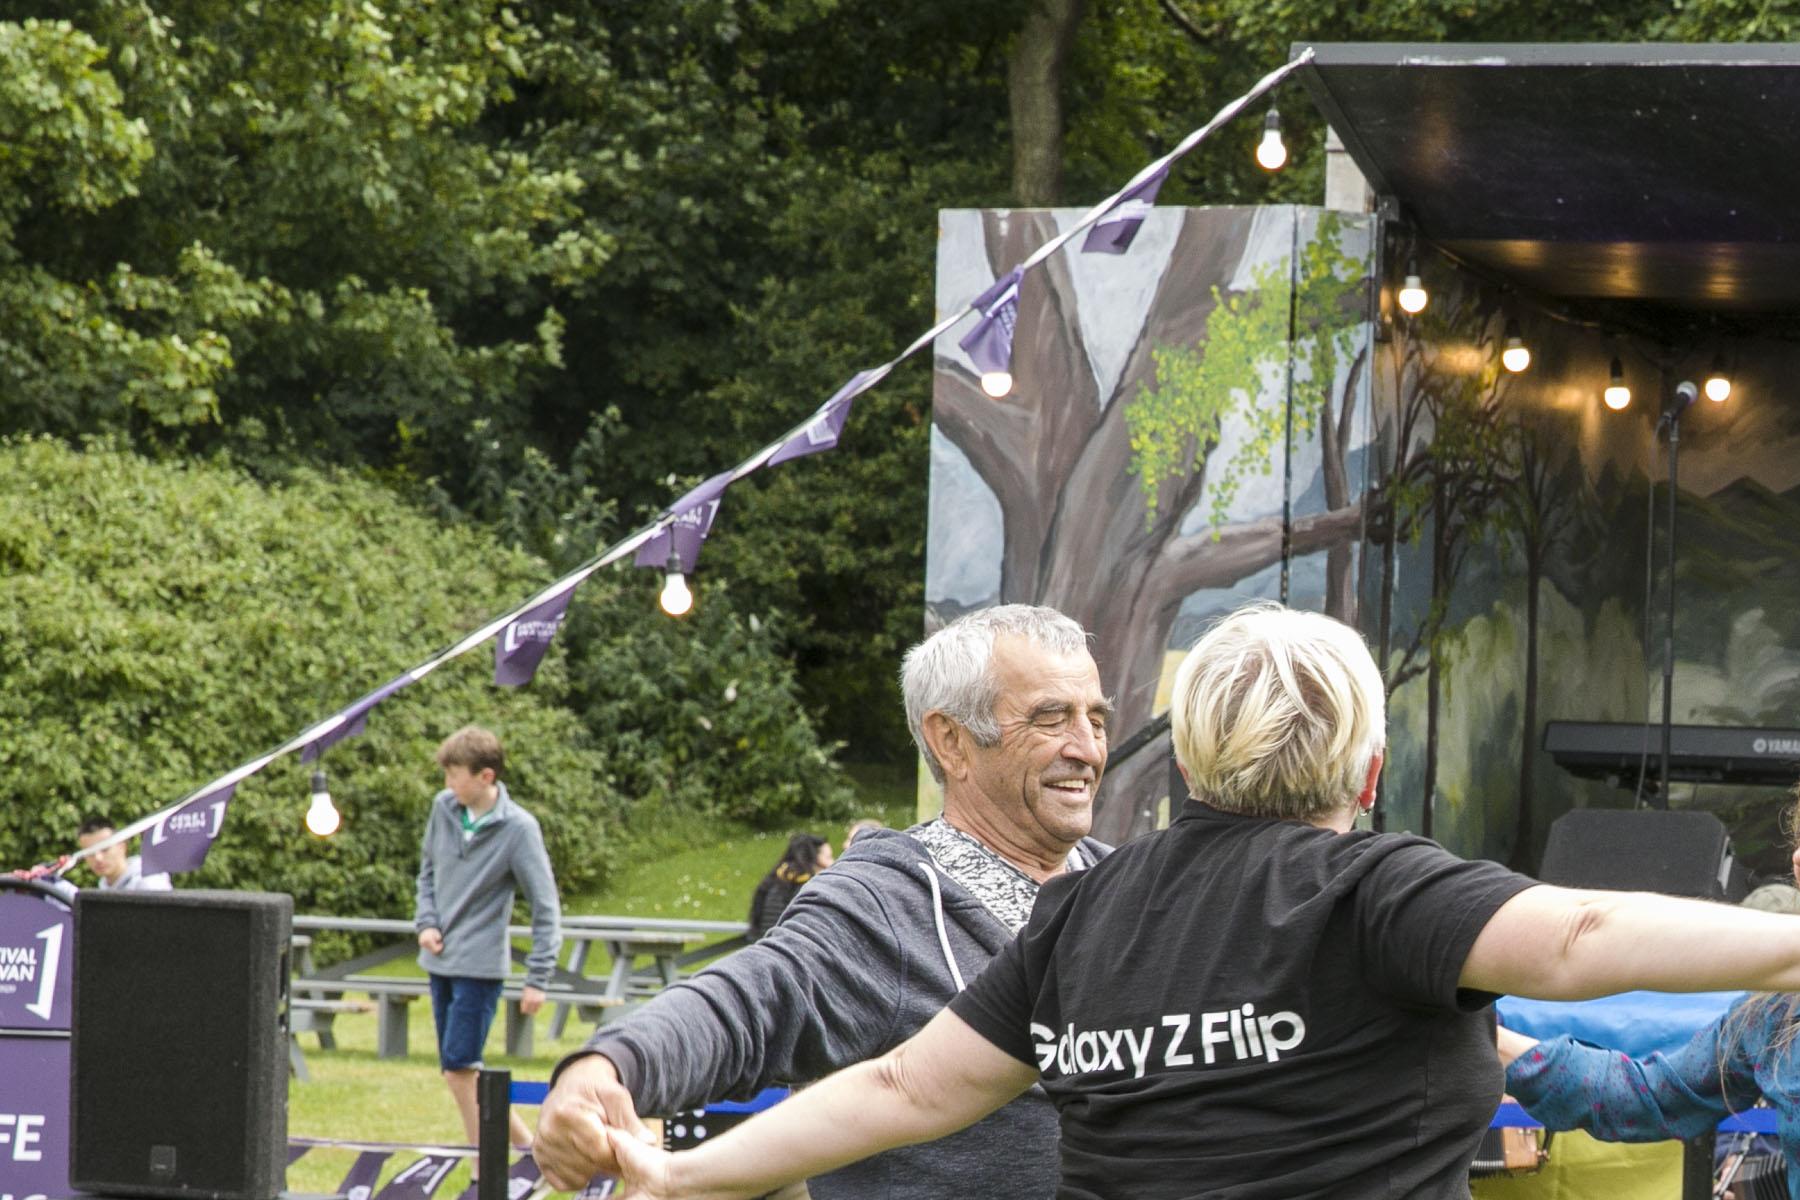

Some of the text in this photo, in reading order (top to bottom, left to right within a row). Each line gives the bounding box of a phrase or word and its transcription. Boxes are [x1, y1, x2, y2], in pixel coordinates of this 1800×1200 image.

[1030, 1002, 1306, 1079] Galaxy Z Flip
